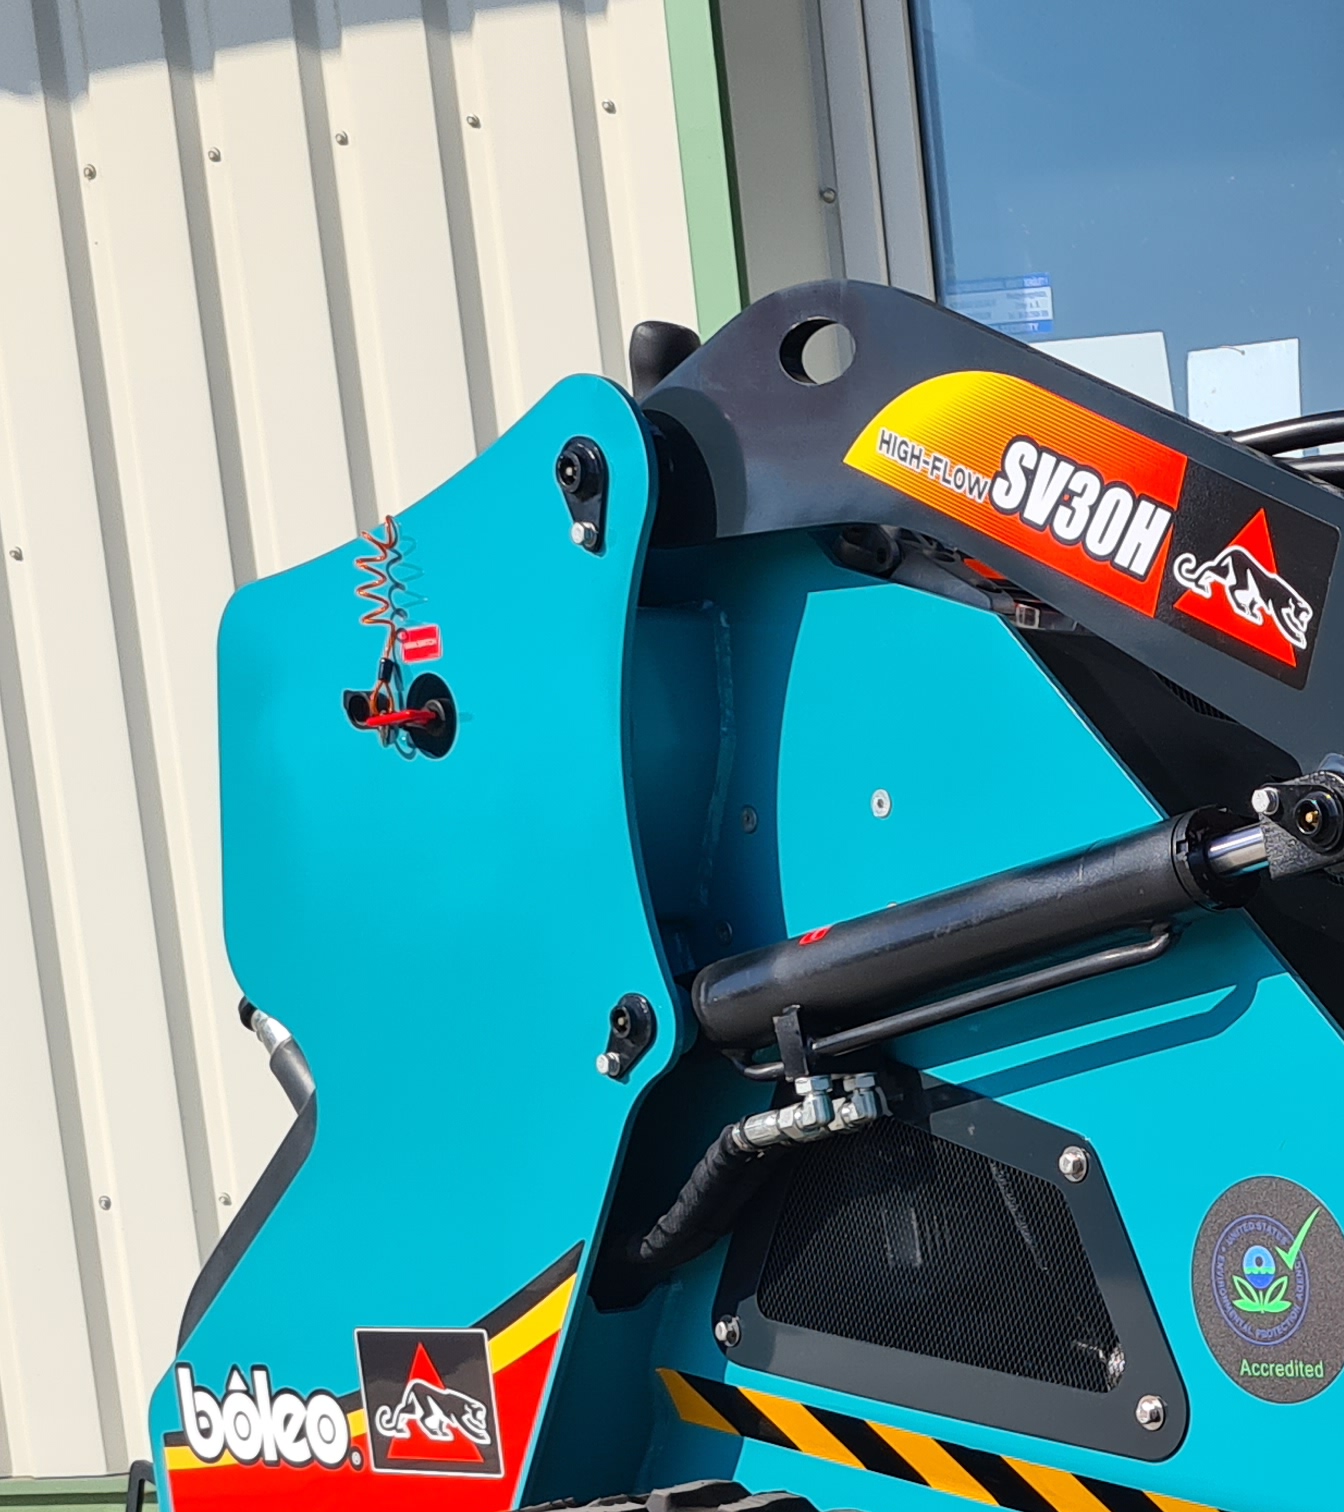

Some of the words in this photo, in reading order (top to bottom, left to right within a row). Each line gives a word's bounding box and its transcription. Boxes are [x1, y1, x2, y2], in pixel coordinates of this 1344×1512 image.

[877, 429, 991, 502] HIGH-FLOW
[991, 437, 1174, 579] SV30H
[1226, 1221, 1255, 1246] UNITED
[1255, 1303, 1302, 1338] PROTECTION
[1240, 1359, 1324, 1378] Accredited
